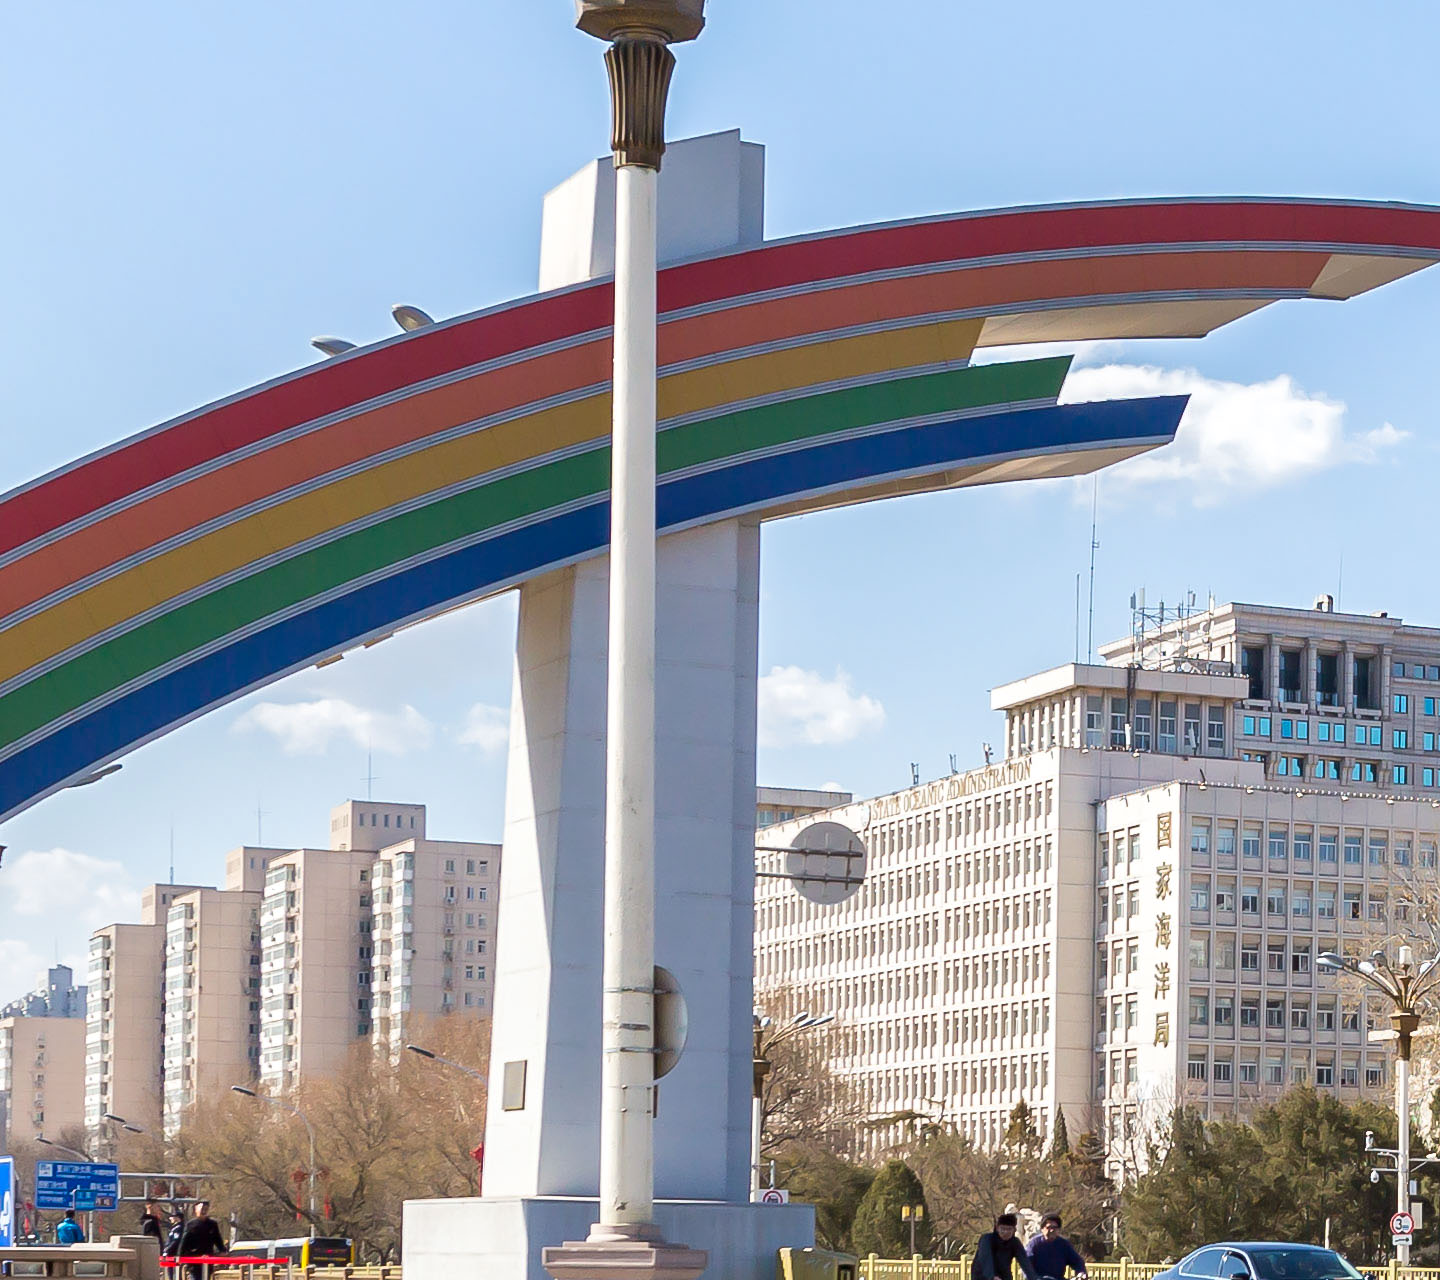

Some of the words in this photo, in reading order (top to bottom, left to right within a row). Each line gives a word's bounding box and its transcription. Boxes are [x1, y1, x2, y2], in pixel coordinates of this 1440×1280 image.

[872, 796, 901, 820] STATE
[903, 782, 944, 812] OCEANIC
[946, 761, 1032, 801] ADMINISTRATION
[1153, 810, 1173, 1049] 国家海洋局
